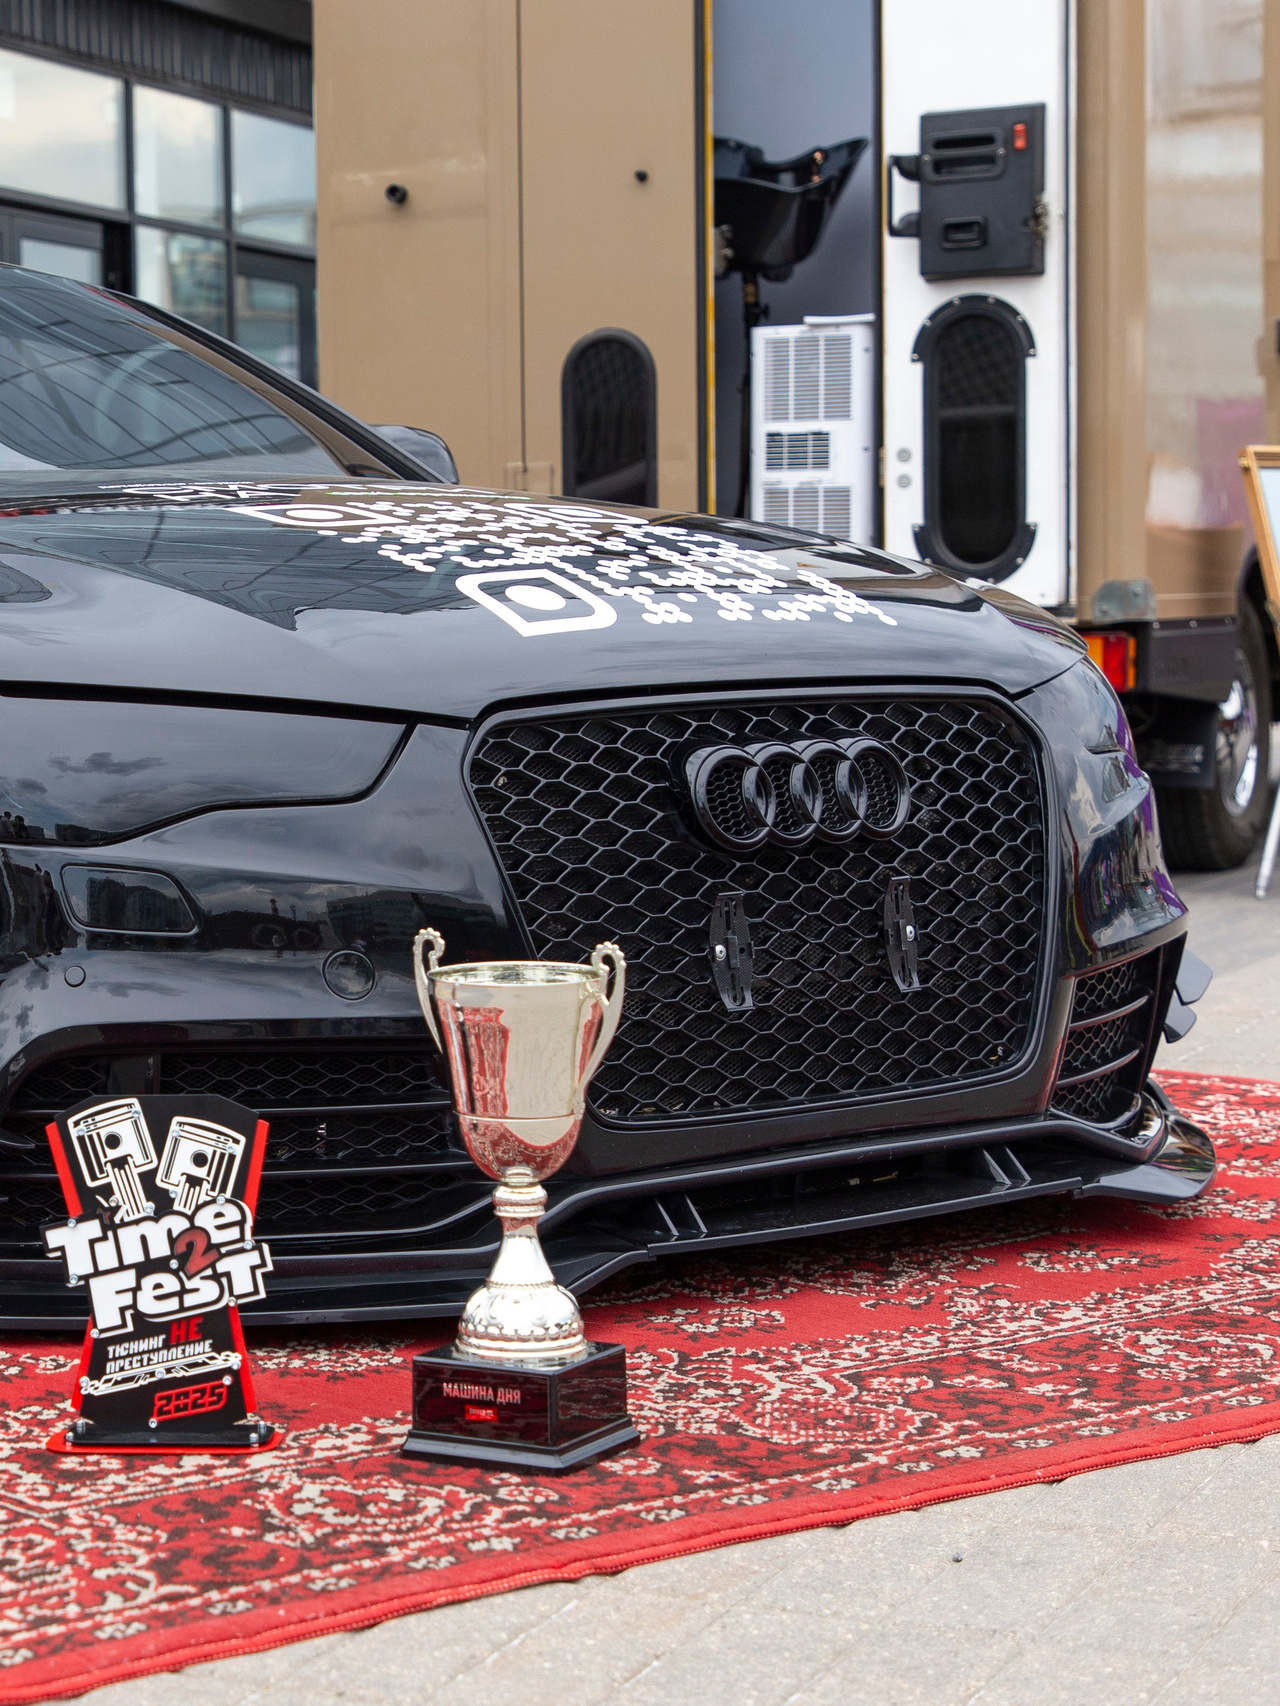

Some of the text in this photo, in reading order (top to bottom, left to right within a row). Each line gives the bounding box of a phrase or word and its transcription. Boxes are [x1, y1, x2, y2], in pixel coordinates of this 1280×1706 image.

[174, 1229, 220, 1276] 2
[106, 1339, 213, 1374] ПРЕСТУПЛЕНИЕ
[107, 1316, 204, 1359] ТЮНИНГ НЕ
[154, 1380, 227, 1420] 2025
[443, 1382, 521, 1405] МАШИНА ДНЯ
